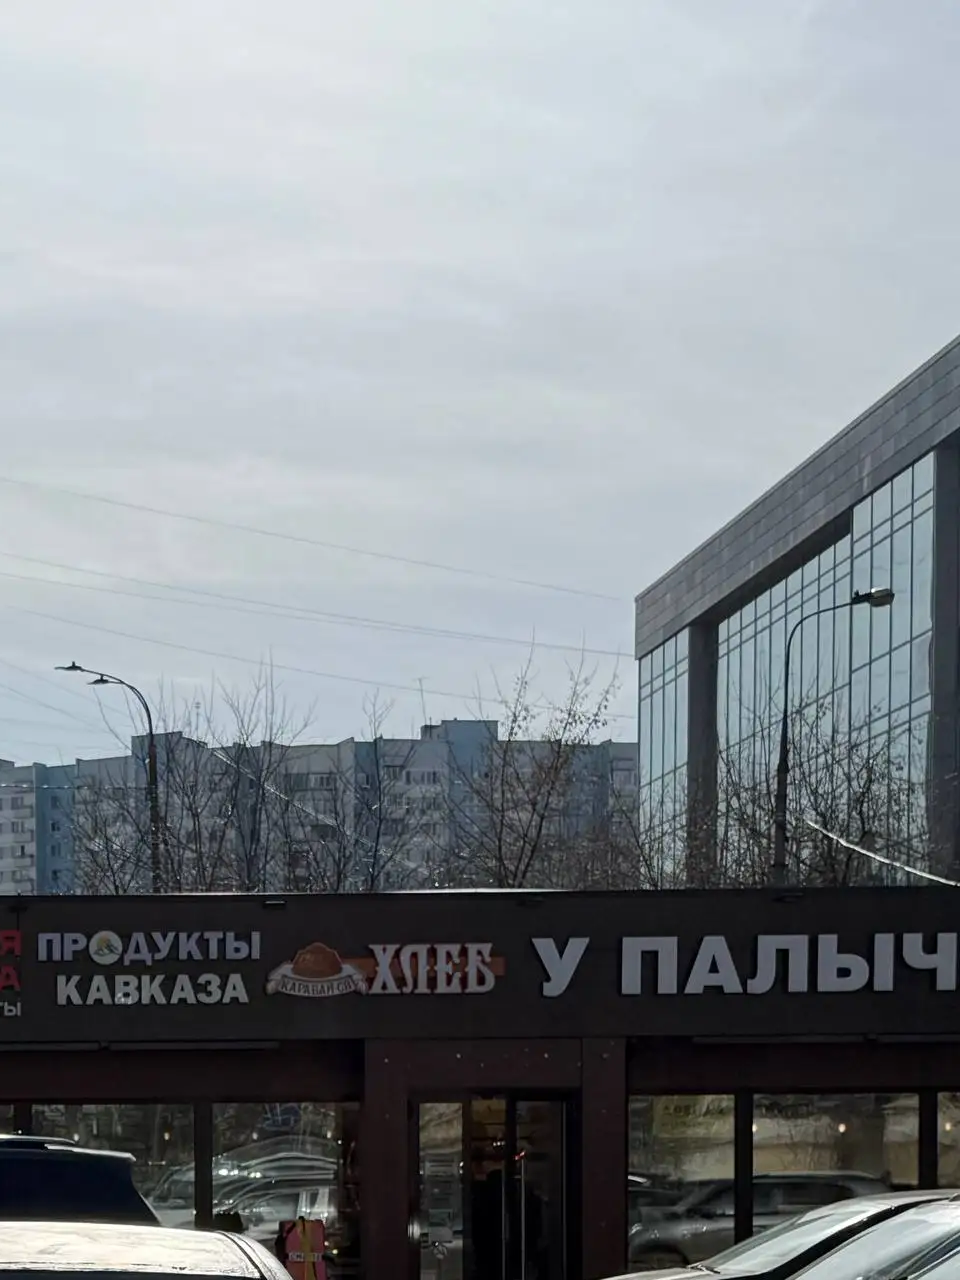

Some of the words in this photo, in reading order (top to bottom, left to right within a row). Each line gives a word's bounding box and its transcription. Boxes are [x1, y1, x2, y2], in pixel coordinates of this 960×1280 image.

[38, 931, 261, 965] ПРОДУКТЫ
[367, 943, 496, 994] ХЛЕБ
[531, 937, 590, 996] У
[621, 932, 958, 994] ПАЛЫЧ
[56, 974, 249, 1005] КАВКАЗА
